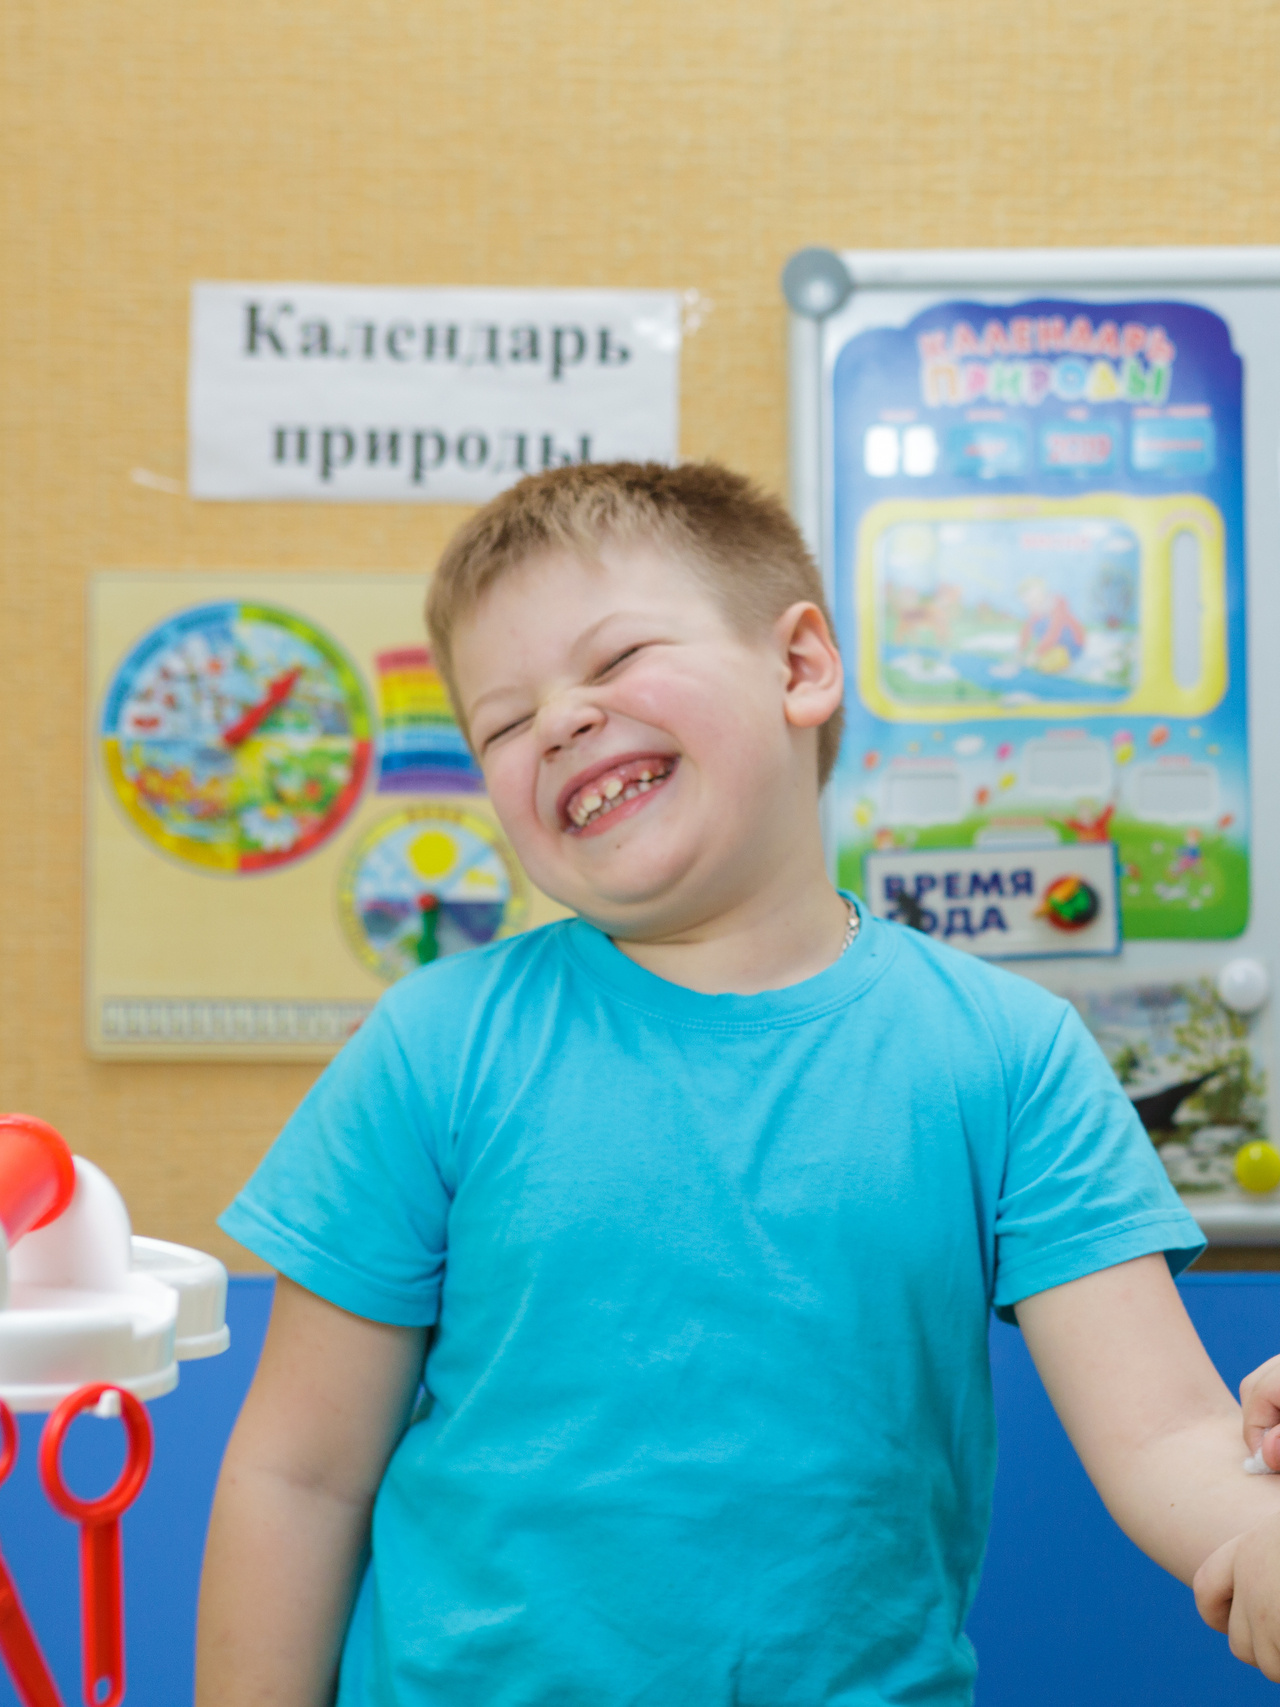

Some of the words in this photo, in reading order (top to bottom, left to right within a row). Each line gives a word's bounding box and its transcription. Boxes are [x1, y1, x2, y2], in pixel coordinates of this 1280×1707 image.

[242, 300, 633, 382] Календарь
[918, 314, 1177, 364] КАЛЕНДАРЬ
[921, 357, 1173, 407] ПРИРОДЫ
[271, 422, 593, 485] природы
[883, 868, 1035, 903] ВРЕМЯ
